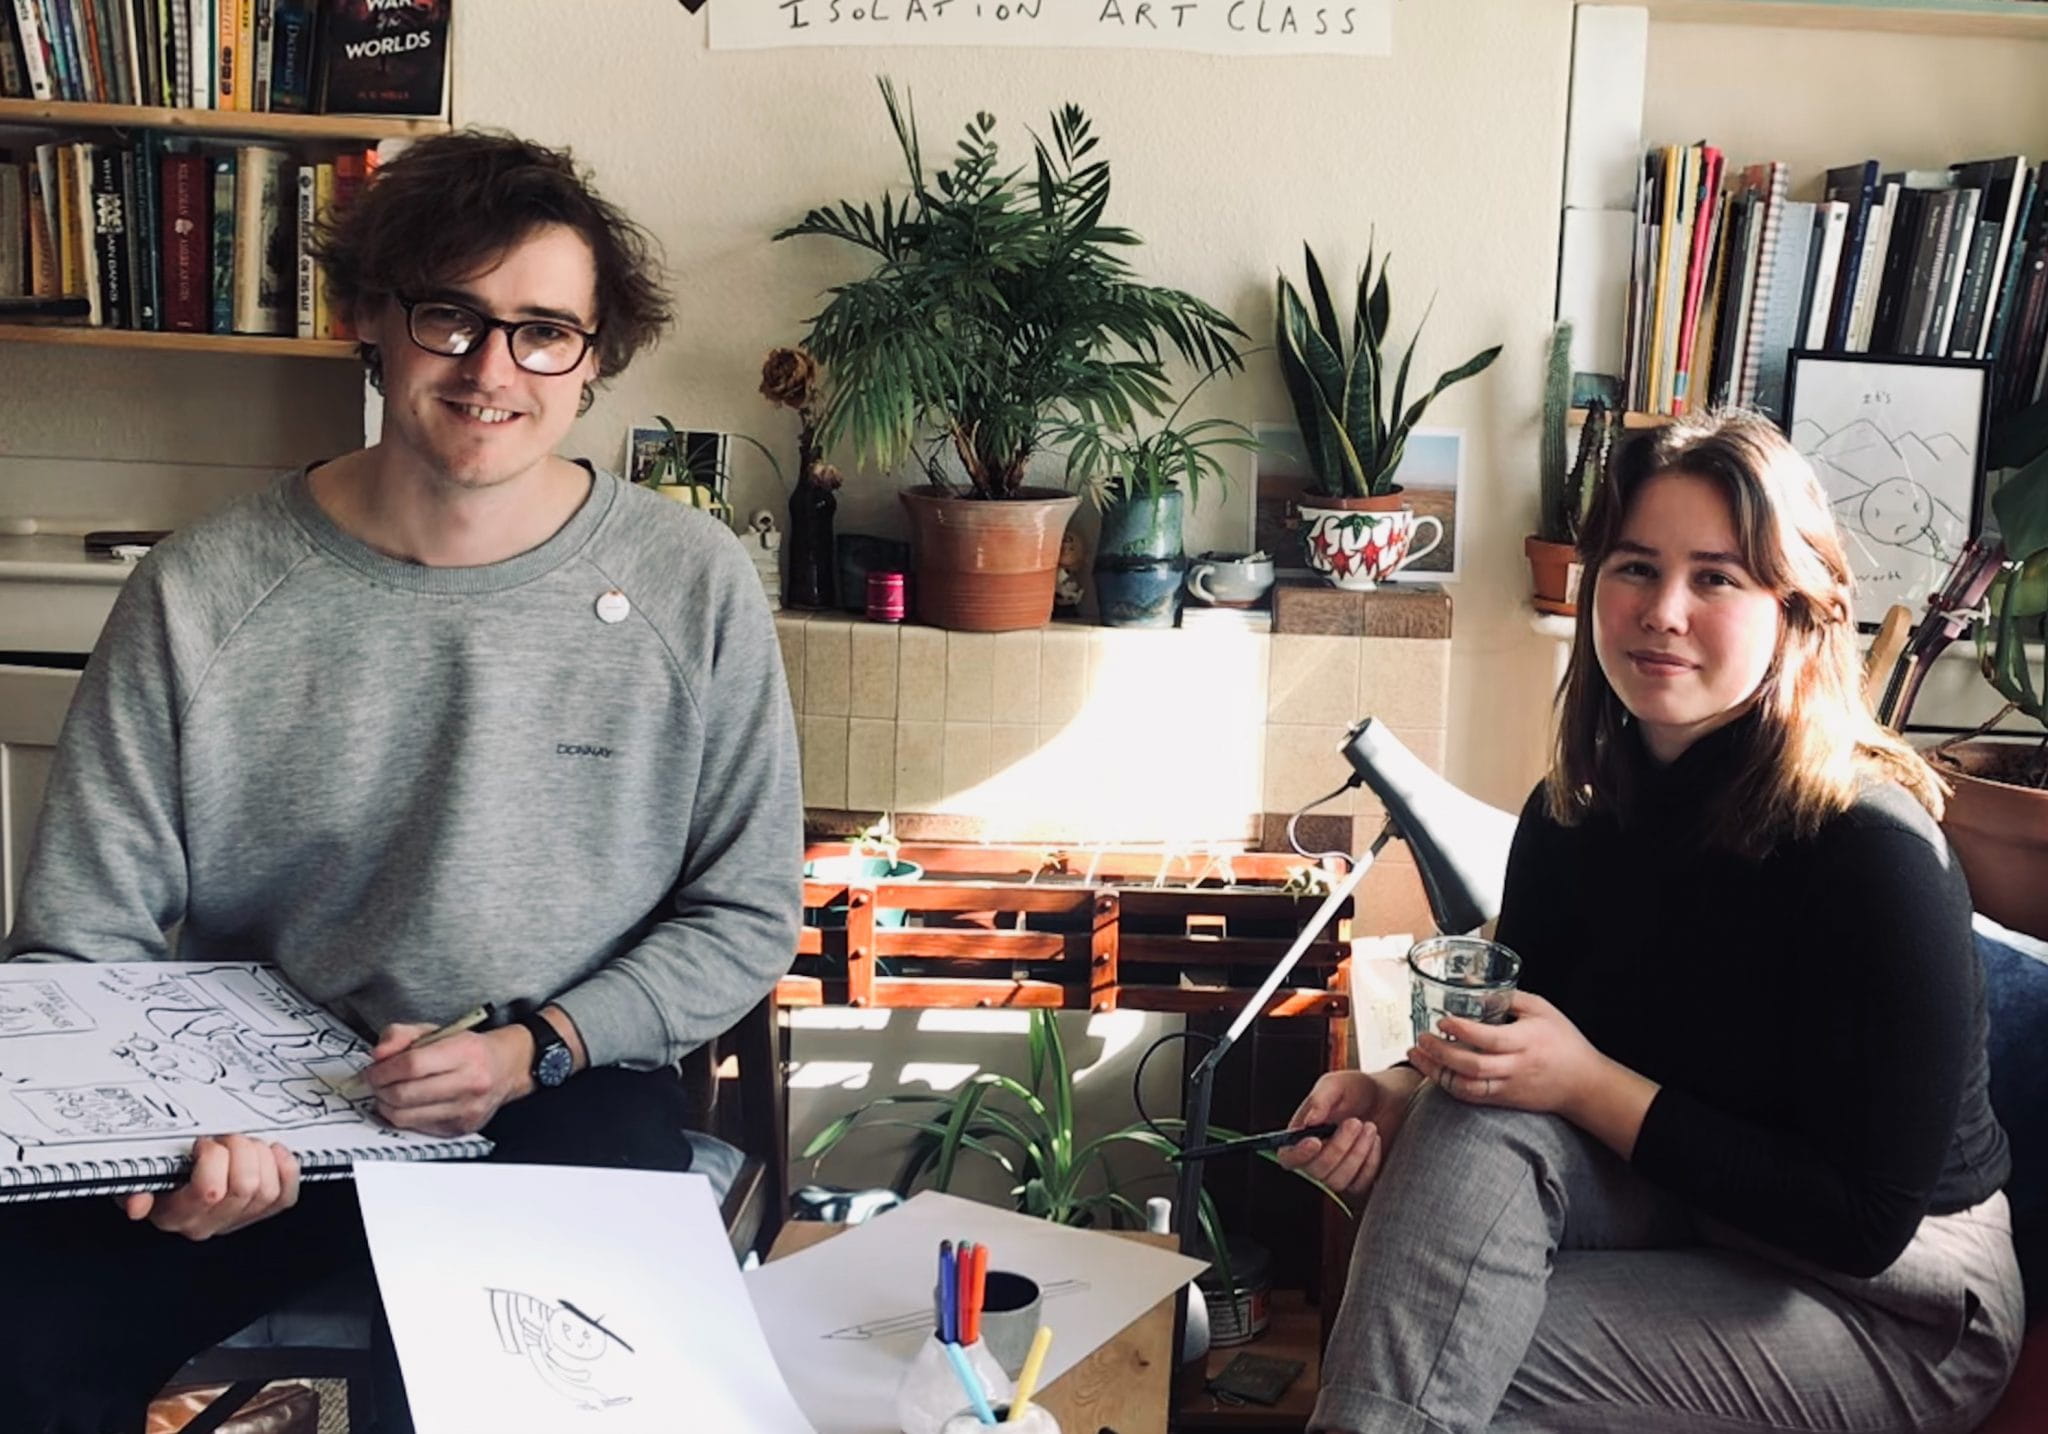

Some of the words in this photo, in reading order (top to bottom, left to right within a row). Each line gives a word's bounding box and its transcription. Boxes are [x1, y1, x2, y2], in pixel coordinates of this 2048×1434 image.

[779, 0, 1041, 28] ISOLATION
[1099, 0, 1199, 29] ART
[1227, 0, 1356, 35] CLASS
[345, 30, 431, 60] WORLDS
[1863, 390, 1891, 405] It's
